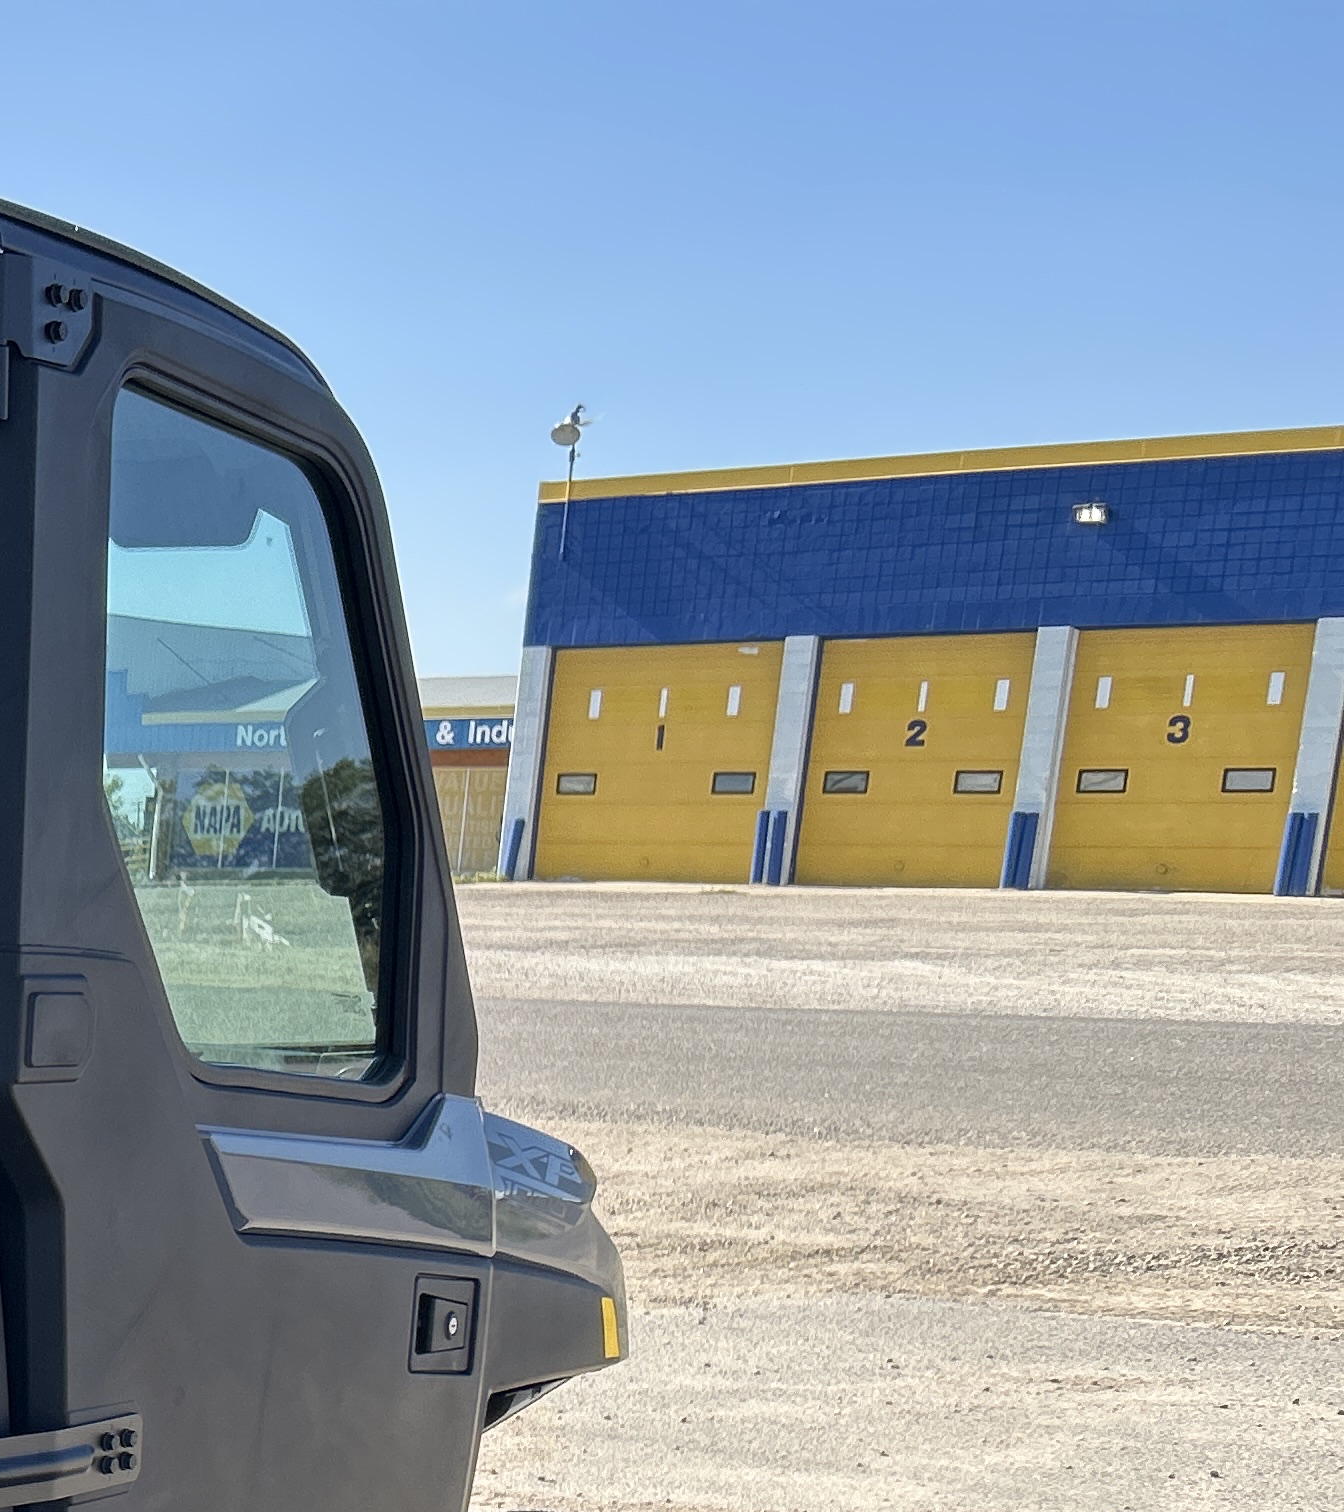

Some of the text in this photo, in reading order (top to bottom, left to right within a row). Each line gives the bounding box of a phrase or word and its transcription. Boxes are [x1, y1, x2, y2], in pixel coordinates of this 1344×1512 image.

[435, 720, 455, 745] &
[655, 724, 666, 751] 1
[904, 718, 928, 748] 2
[1165, 714, 1192, 745] 3
[193, 803, 242, 835] NAPA
[494, 1131, 582, 1187] XP
